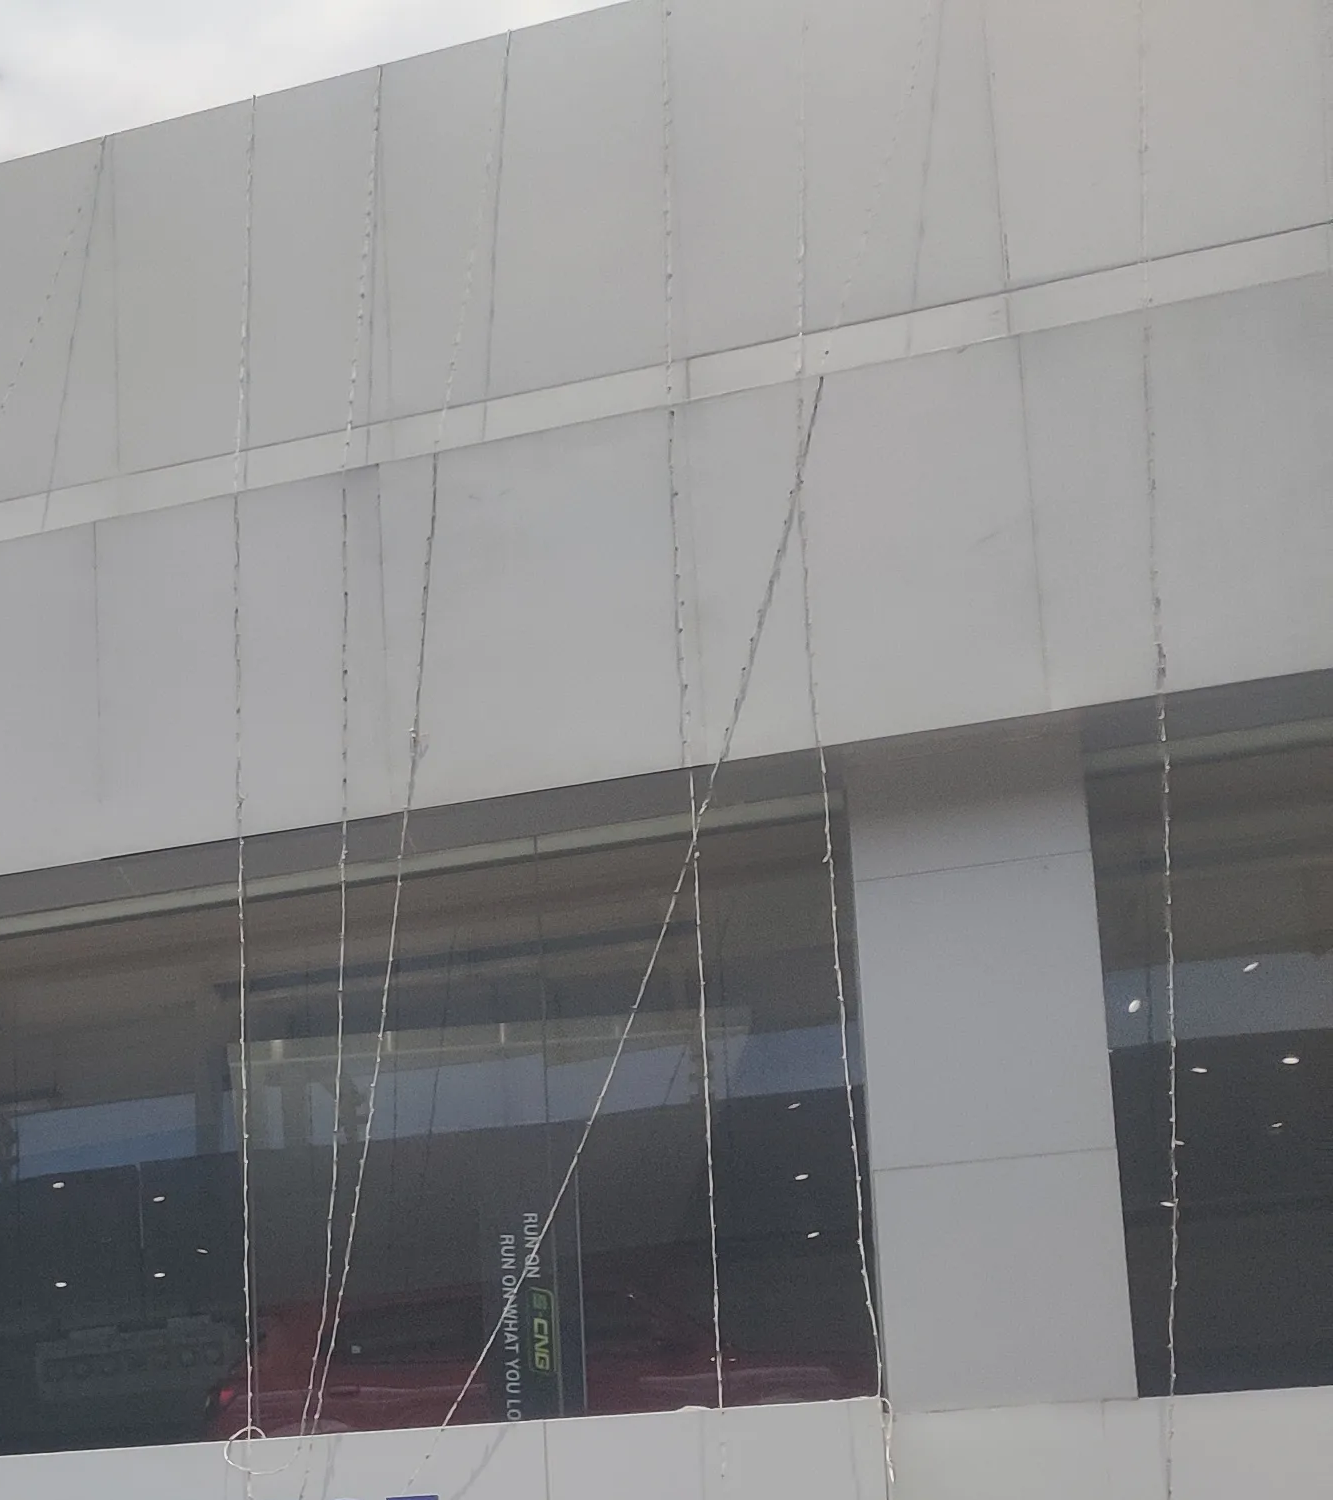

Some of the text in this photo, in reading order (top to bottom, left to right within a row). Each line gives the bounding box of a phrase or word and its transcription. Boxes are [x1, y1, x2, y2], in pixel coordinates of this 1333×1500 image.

[523, 1212, 538, 1249] RUN
[500, 1234, 516, 1270] RUN
[504, 1357, 521, 1394] YOU
[507, 1399, 521, 1421] LO
